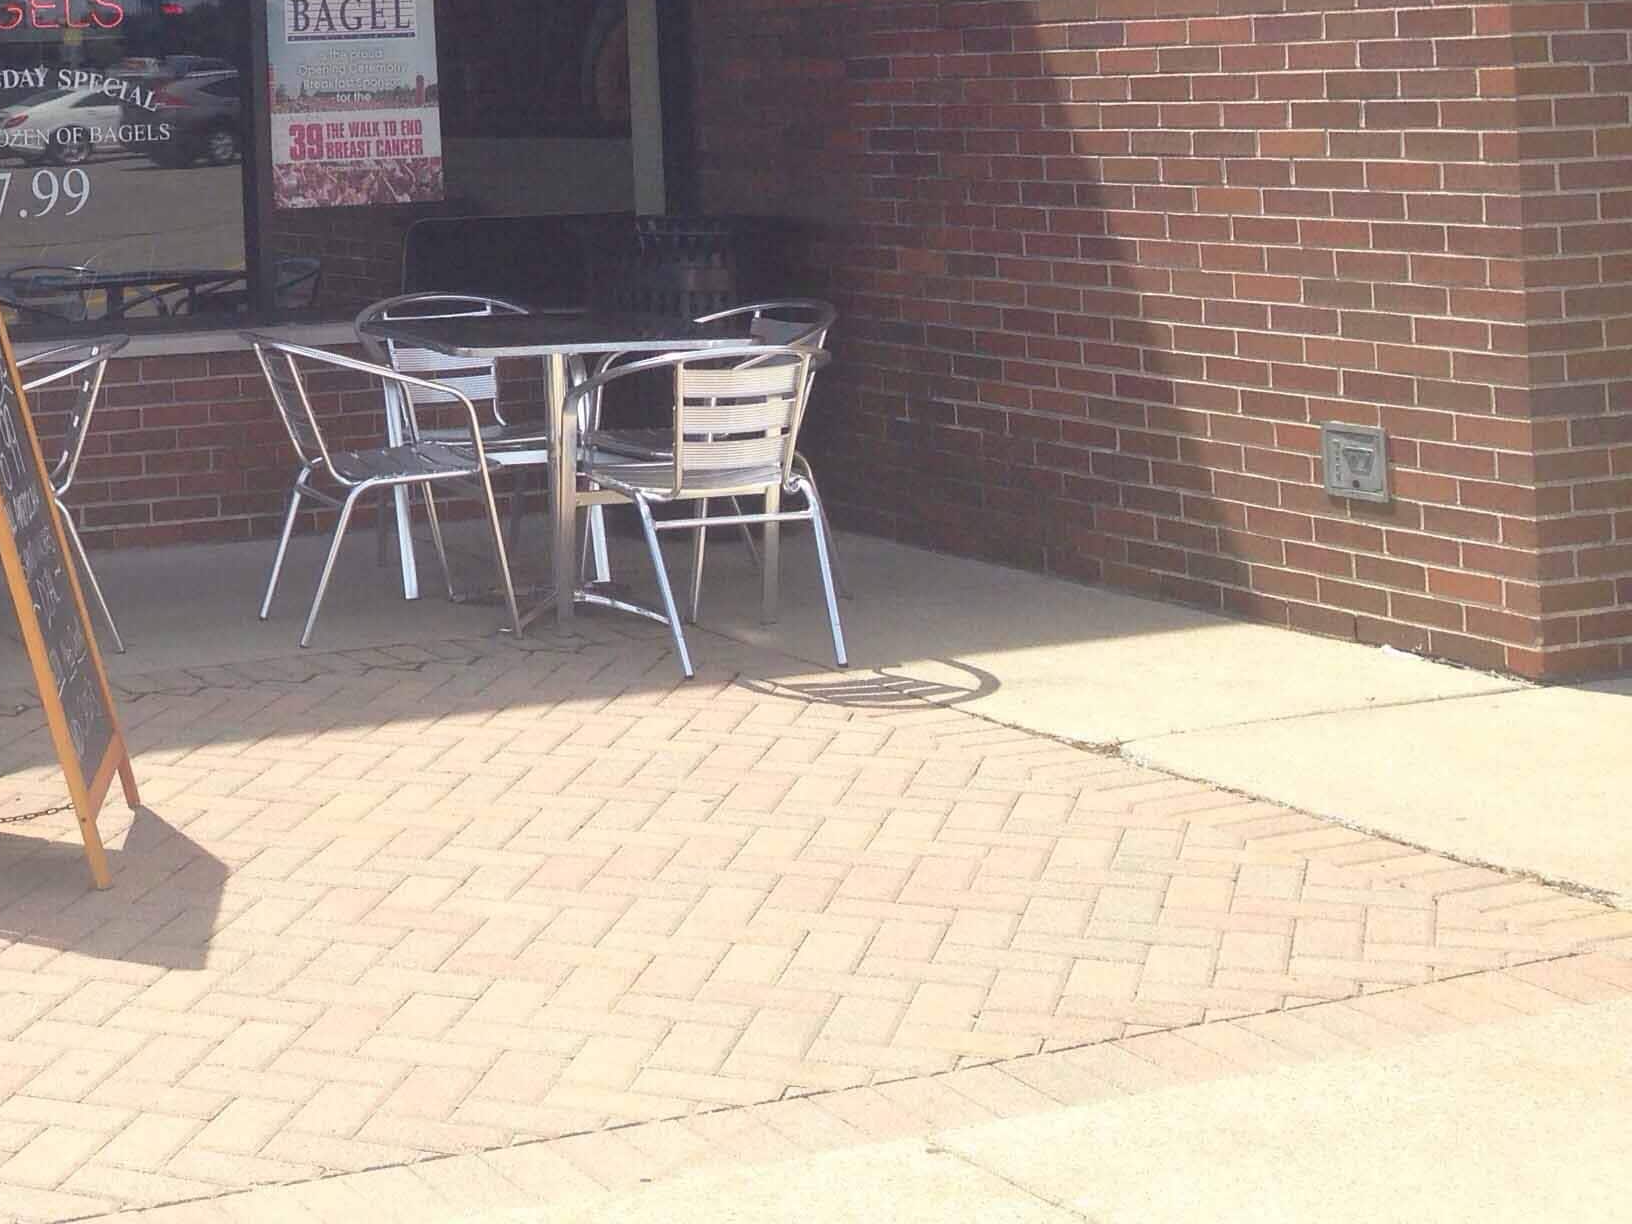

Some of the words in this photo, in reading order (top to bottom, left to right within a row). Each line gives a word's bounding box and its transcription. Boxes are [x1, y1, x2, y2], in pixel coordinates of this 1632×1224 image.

[56, 69, 161, 113] SPECIAL
[55, 128, 84, 147] OF
[89, 123, 171, 145] BAGELS
[325, 122, 345, 139] THE
[347, 121, 381, 138] WALK
[382, 120, 398, 137] TO
[400, 119, 423, 136] END
[288, 123, 324, 162] 39
[325, 140, 372, 160] BREAST
[375, 138, 424, 158] CANCER
